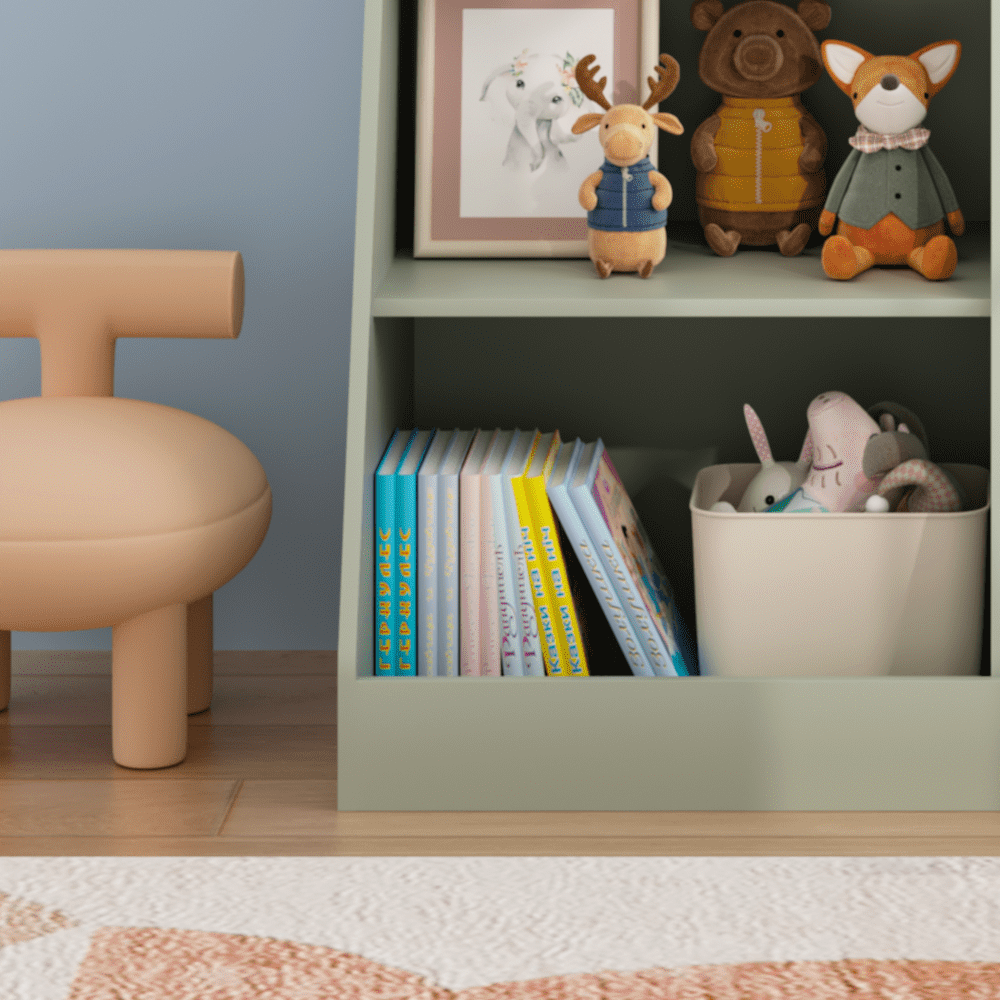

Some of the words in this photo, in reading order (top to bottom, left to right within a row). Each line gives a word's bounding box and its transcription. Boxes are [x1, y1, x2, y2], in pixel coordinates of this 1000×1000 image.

[521, 526, 536, 561] ніч
[541, 527, 557, 561] ніч
[379, 527, 391, 670] ГЕРКУЛЕС
[399, 527, 411, 670] ГЕРКУЛЕС
[530, 568, 544, 598] на
[551, 569, 565, 598] на
[539, 606, 562, 673] Казки
[559, 605, 582, 673] Казки
